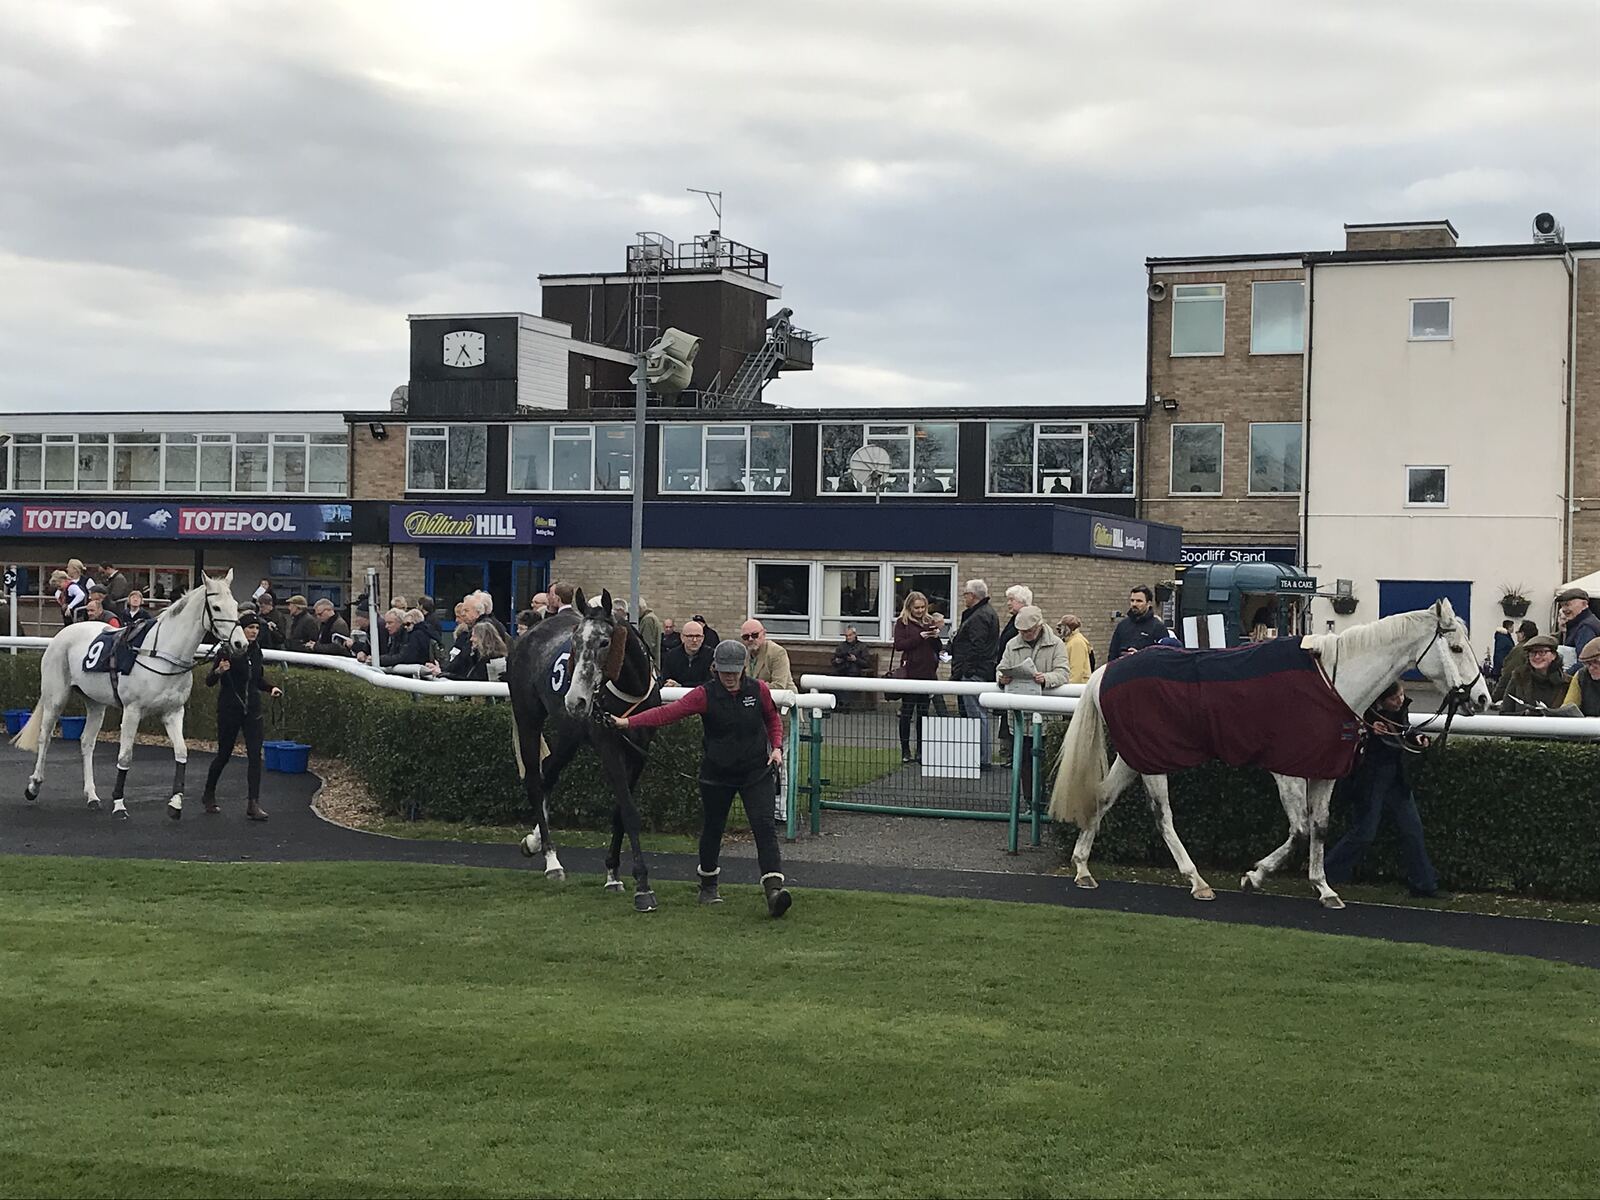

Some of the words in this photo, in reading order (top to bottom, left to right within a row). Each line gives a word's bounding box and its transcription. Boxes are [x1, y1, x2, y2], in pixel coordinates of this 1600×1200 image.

[26, 510, 132, 530] TOTEPOOL
[182, 511, 297, 532] TOTEPOOL
[404, 510, 477, 537] William
[476, 514, 517, 536] HILL
[1229, 550, 1266, 562] Stand
[1280, 580, 1292, 588] TEA
[1298, 580, 1314, 589] CAKE
[85, 641, 105, 669] 9
[551, 652, 571, 692] 5
